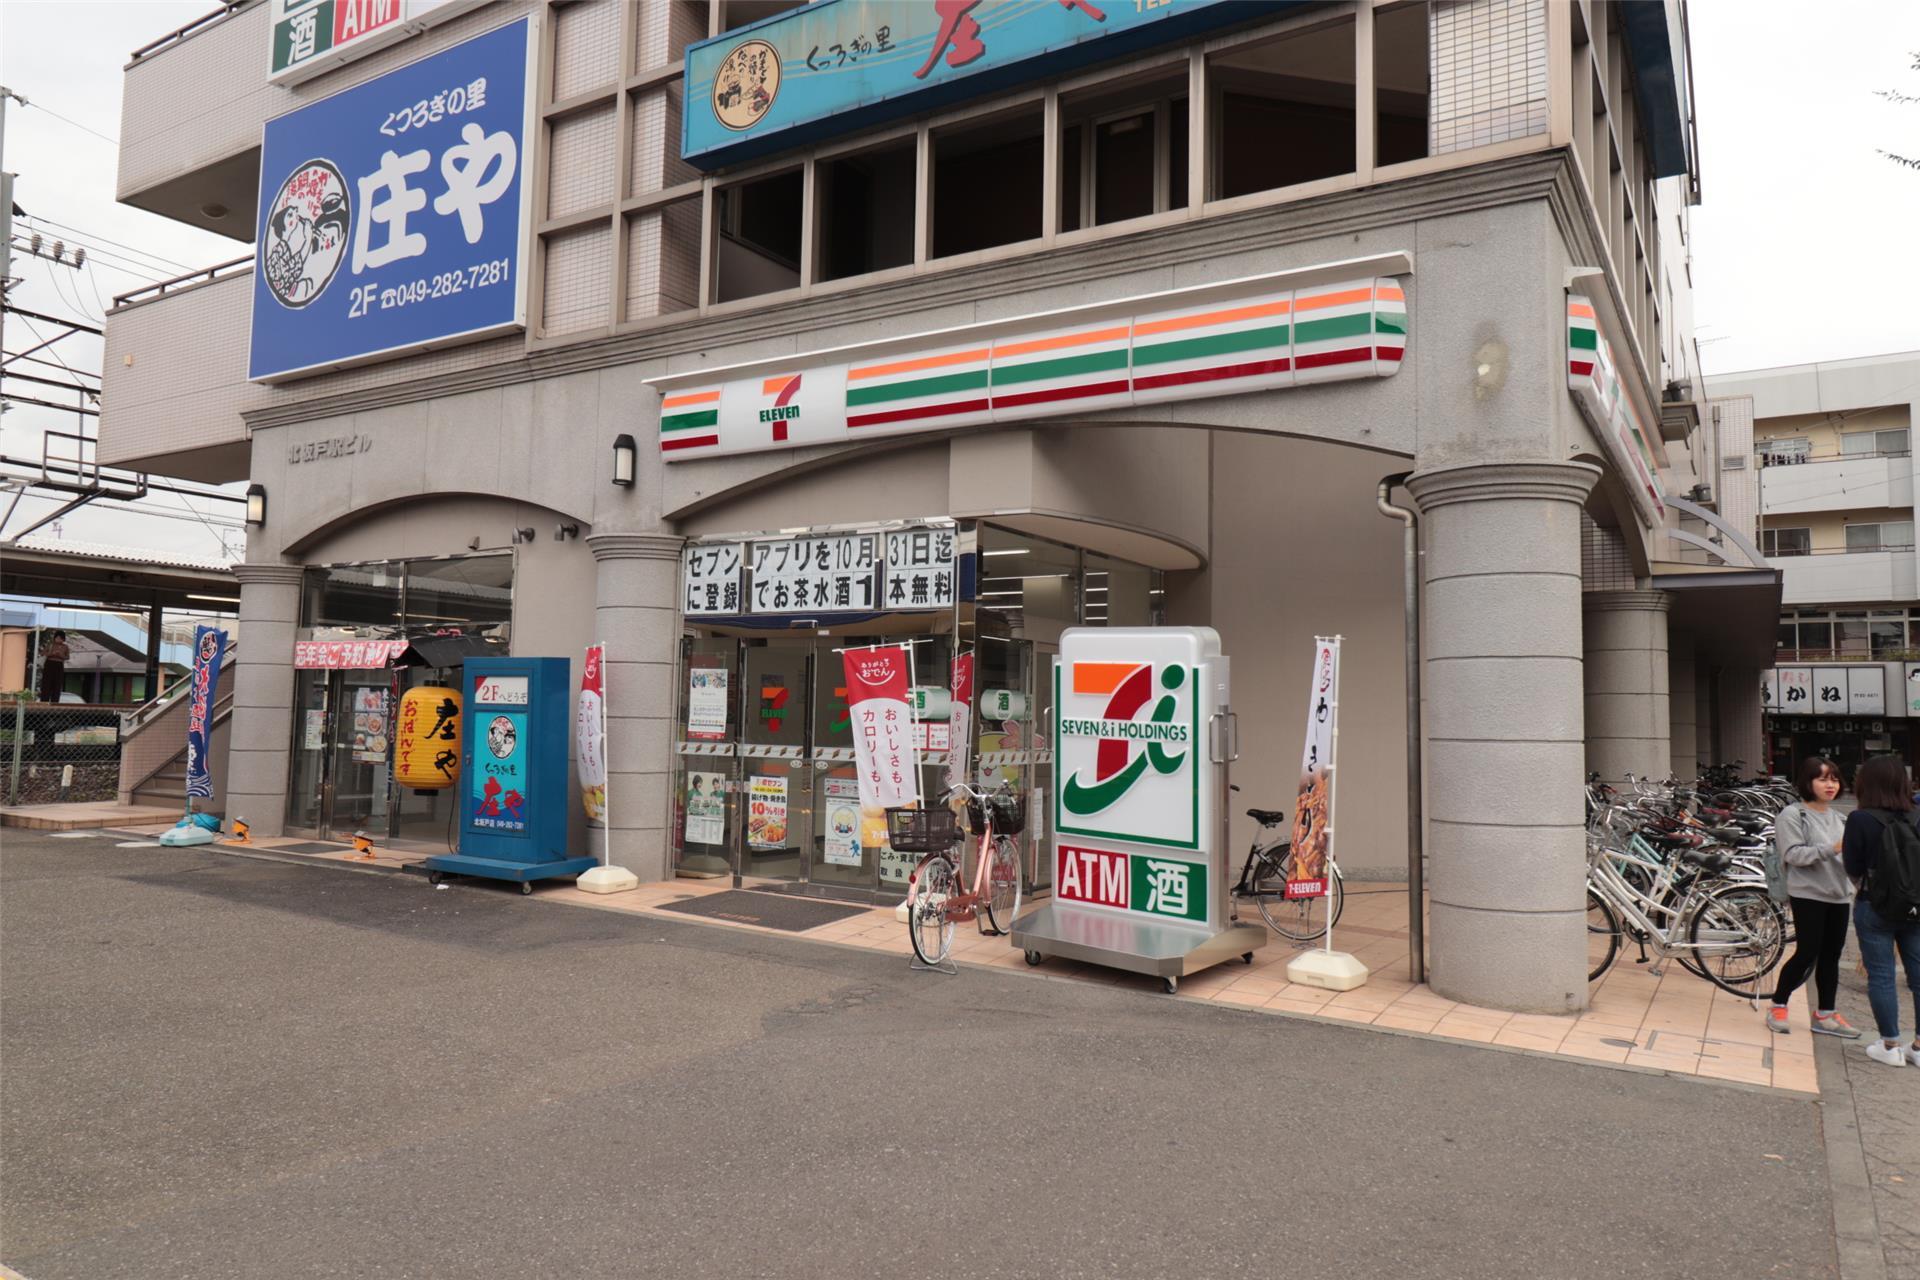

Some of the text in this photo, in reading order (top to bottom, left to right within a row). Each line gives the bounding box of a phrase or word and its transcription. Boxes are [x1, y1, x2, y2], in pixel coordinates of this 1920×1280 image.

[287, 7, 319, 66] 酒
[341, 0, 392, 40] ATM
[805, 25, 897, 71] くつろぎの里
[379, 78, 487, 136] くつろぎの里
[351, 122, 517, 275] 庄や
[349, 258, 509, 318] 2F 049-282-7281
[759, 404, 800, 423] ELEVEN
[688, 532, 953, 579] セブン アプリを10月 31日迄
[687, 571, 953, 612] に登録 でお茶水酒1 本無料
[860, 658, 890, 669] ありがとう
[862, 668, 890, 678] おでん
[998, 692, 1010, 711] 酒
[400, 699, 418, 776] おばんです
[424, 697, 459, 780] 庄や
[863, 709, 882, 798] カロリーも!
[884, 708, 903, 800] おいしさも!
[1118, 722, 1188, 741] HOLDINGS
[1060, 850, 1126, 904] ATM
[1146, 860, 1189, 914] 酒
